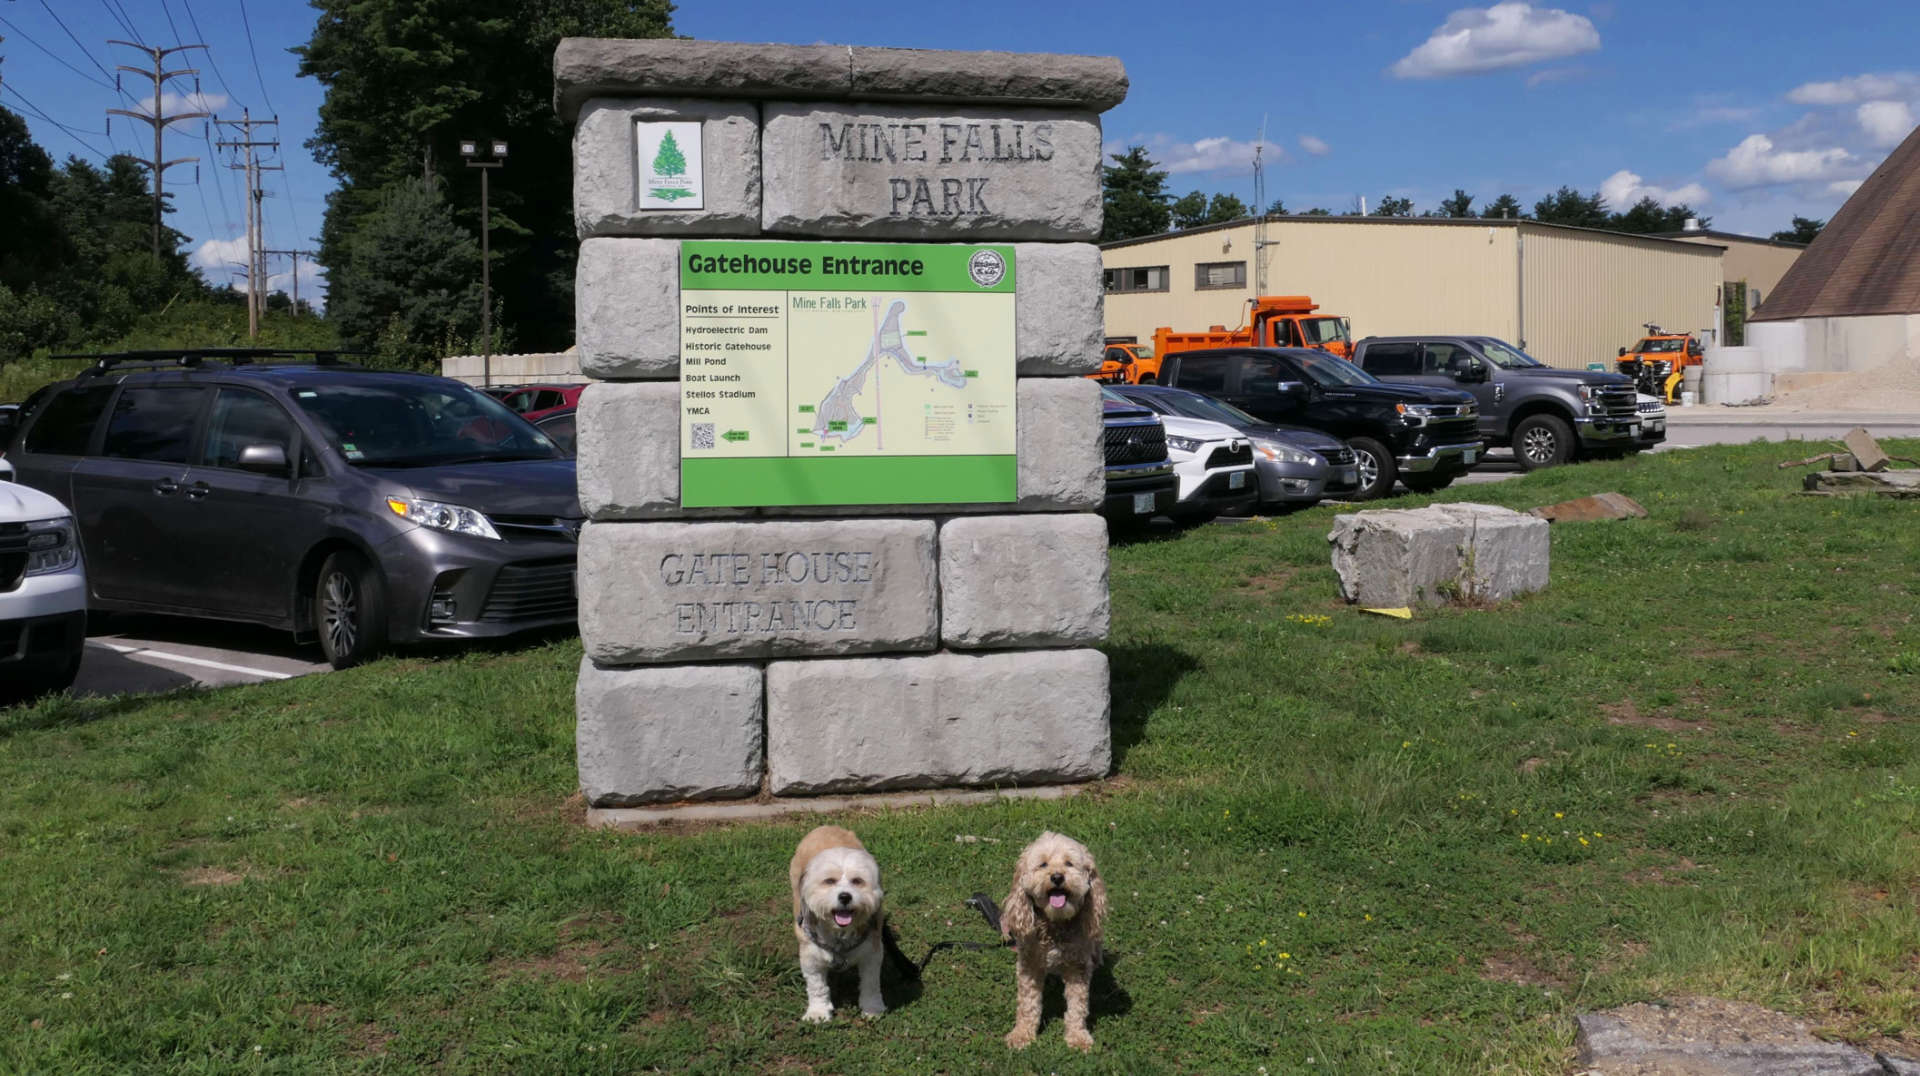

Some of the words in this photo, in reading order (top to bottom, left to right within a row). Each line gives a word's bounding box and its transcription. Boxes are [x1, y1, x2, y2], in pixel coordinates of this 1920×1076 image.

[819, 123, 927, 163] MINE
[939, 123, 1054, 164] FALLS
[889, 178, 991, 216] PARK
[688, 254, 812, 274] Gatehouse
[822, 255, 924, 276] Entrance
[686, 304, 718, 314] Points
[722, 304, 734, 314] of
[738, 305, 780, 314] Interest
[792, 297, 817, 310] Mine
[820, 297, 842, 311] Falls
[845, 297, 867, 311] Park
[685, 326, 745, 335] Hydroelectric
[685, 342, 722, 351] Historic
[725, 343, 772, 351] Gatehouse
[685, 358, 701, 366] Mill
[704, 358, 727, 366] Pond
[685, 374, 706, 382] Boat
[709, 374, 741, 382] Launch
[719, 391, 756, 399] Stadium
[686, 407, 710, 415] YMCA
[660, 553, 751, 586] GATE
[760, 551, 873, 584] HOUSE
[675, 600, 857, 633] ENTRANCE
